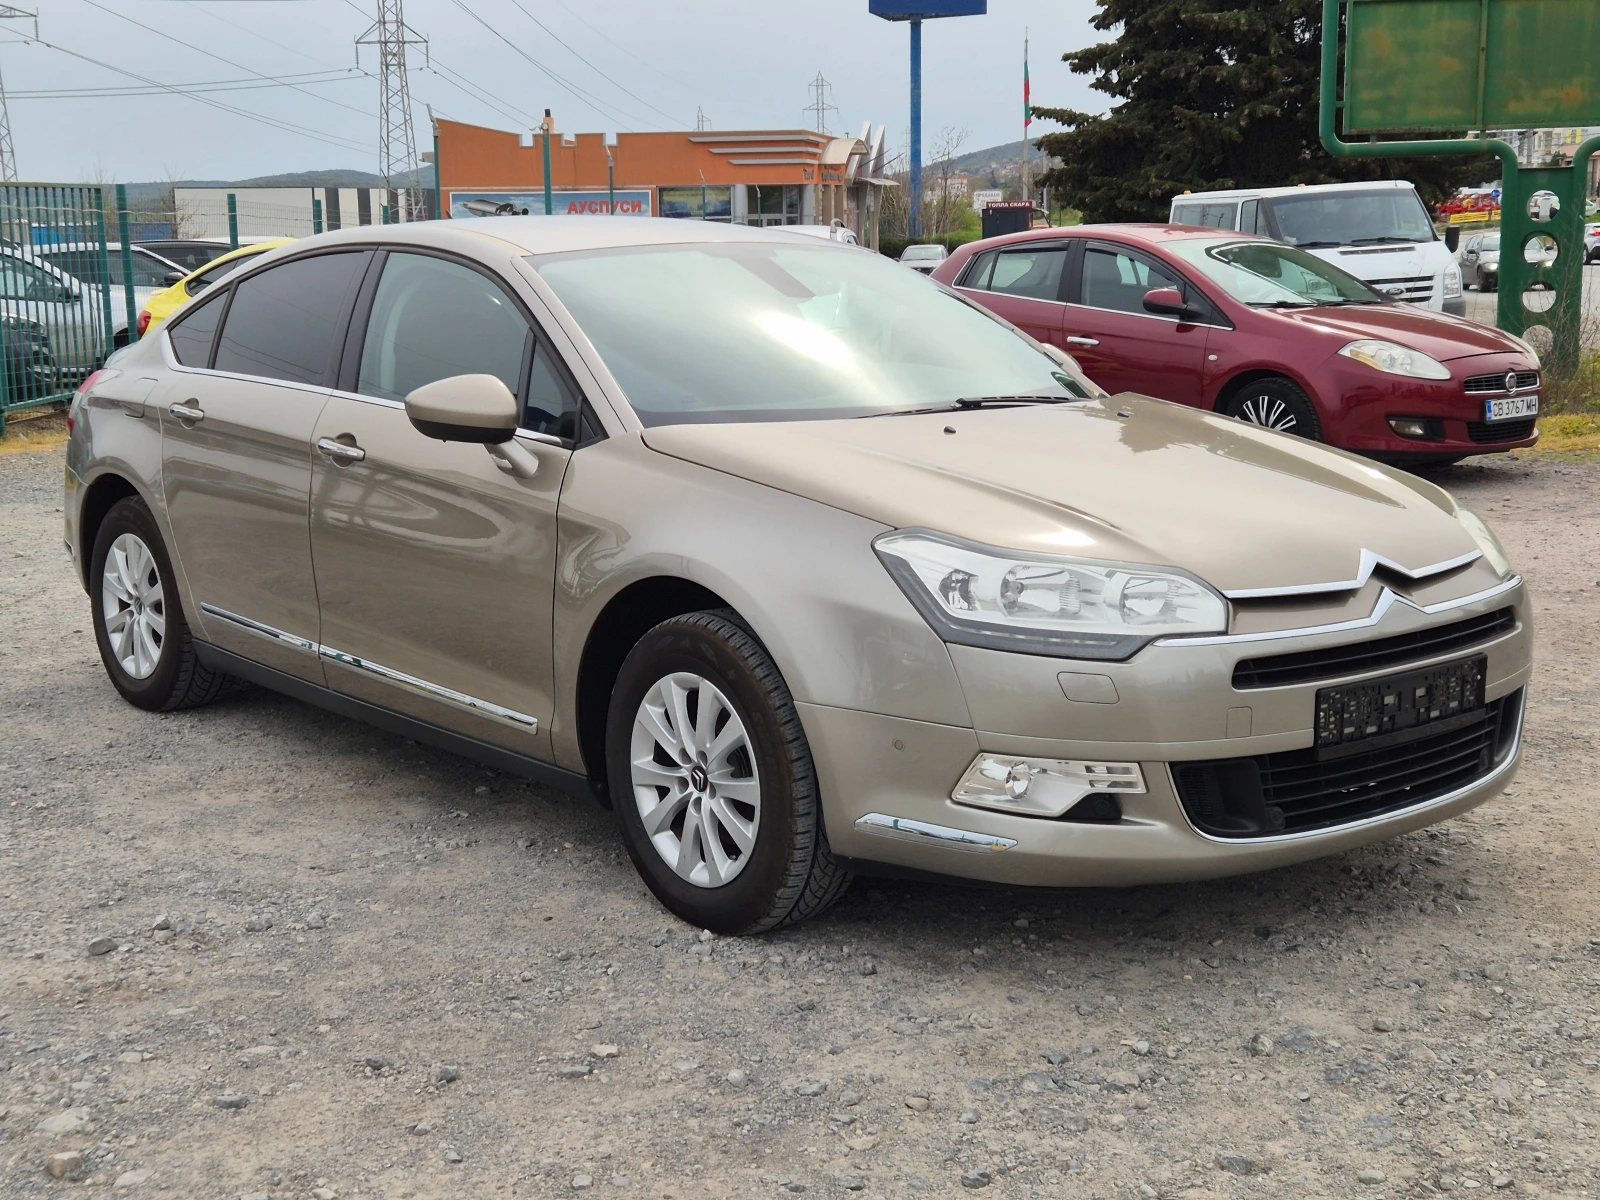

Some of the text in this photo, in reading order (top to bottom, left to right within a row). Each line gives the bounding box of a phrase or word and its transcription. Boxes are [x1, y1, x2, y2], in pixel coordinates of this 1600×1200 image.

[567, 200, 642, 214] АУСПУСИ
[1493, 398, 1536, 417] CB 3767 MH
